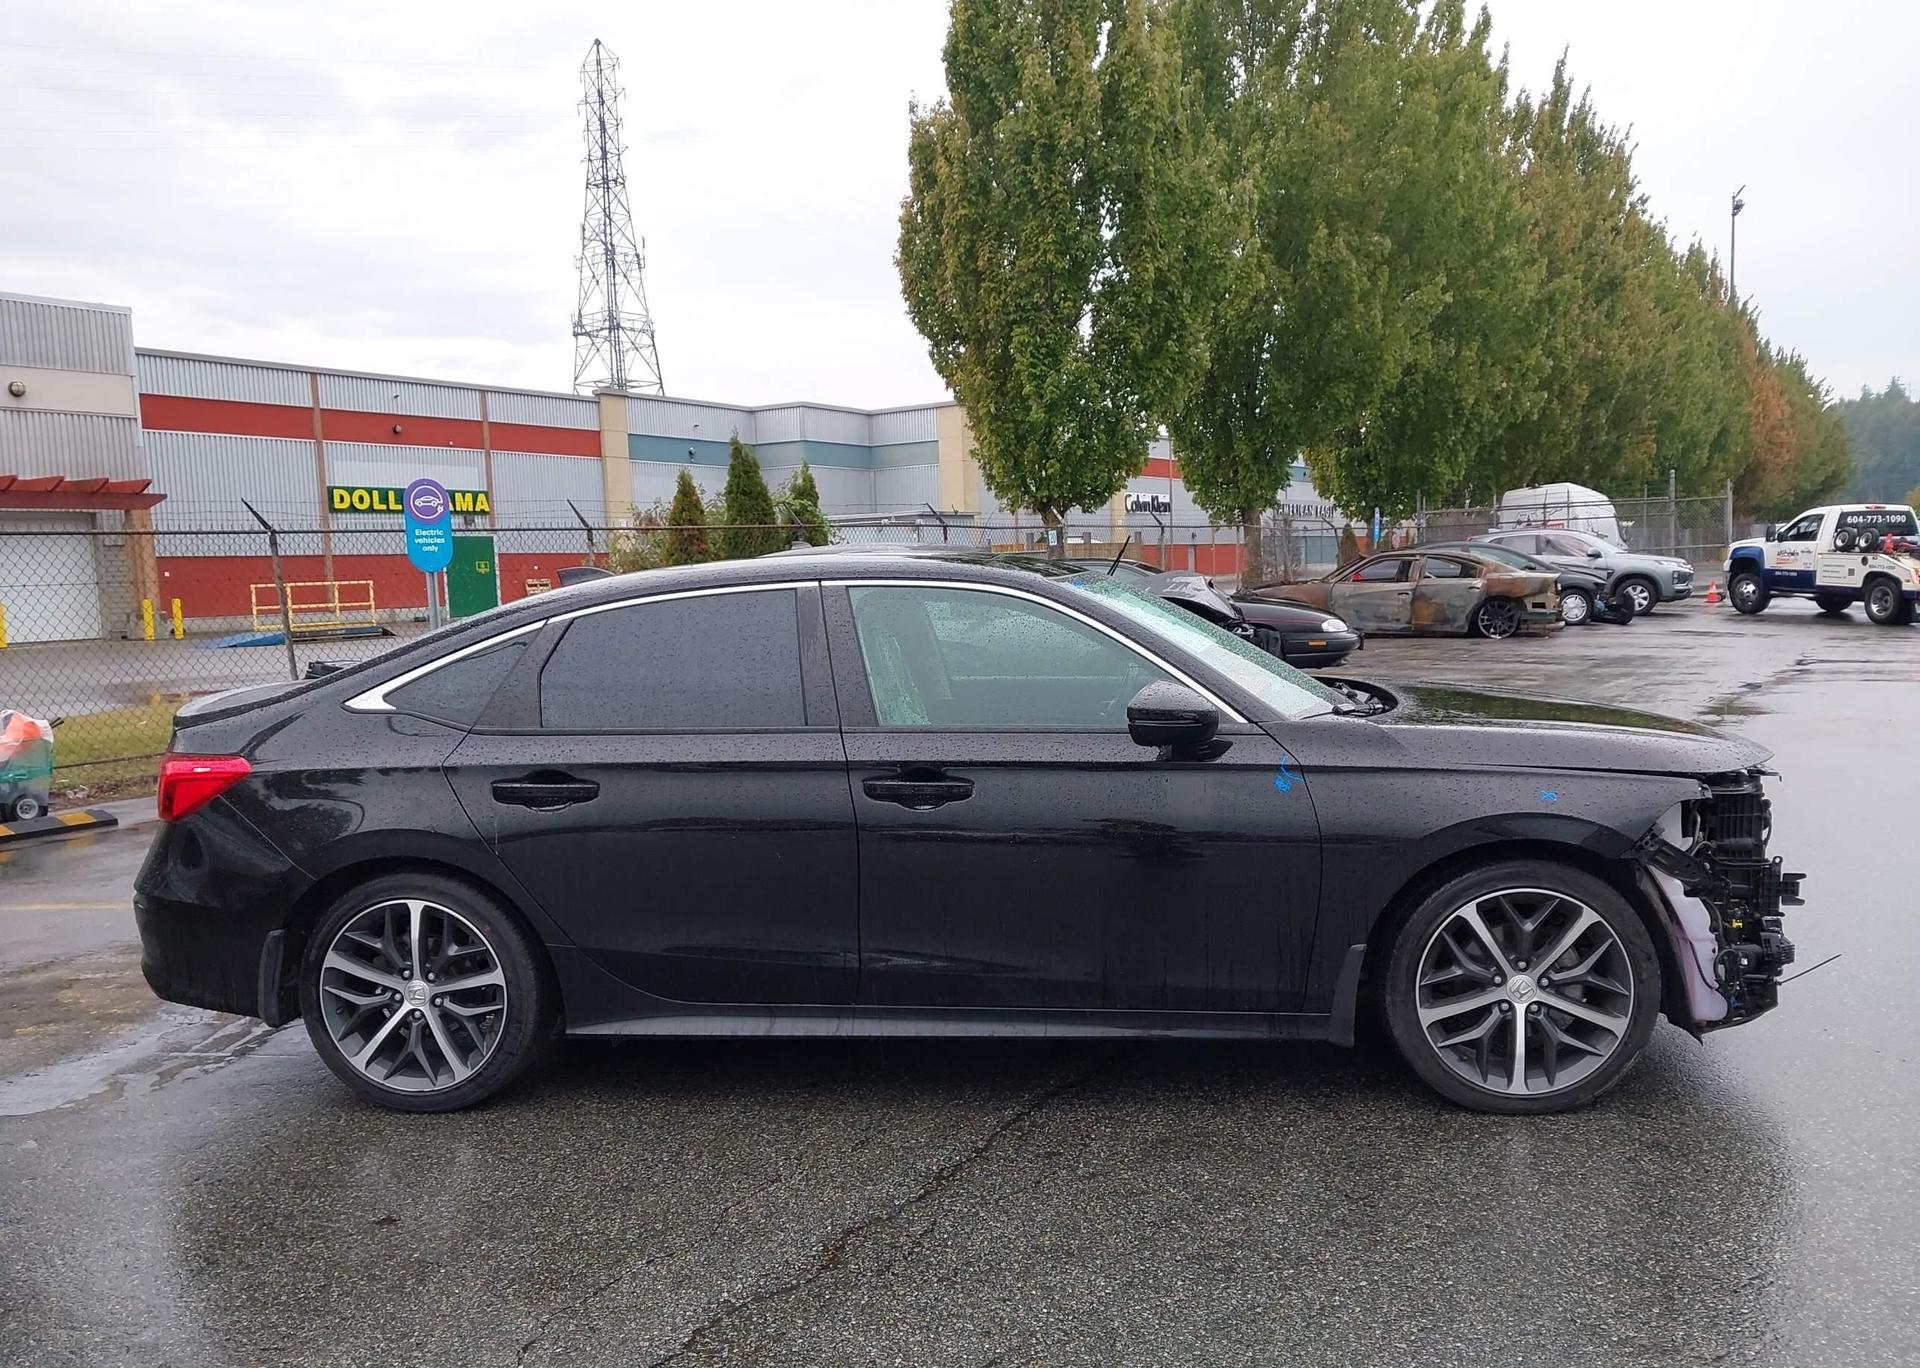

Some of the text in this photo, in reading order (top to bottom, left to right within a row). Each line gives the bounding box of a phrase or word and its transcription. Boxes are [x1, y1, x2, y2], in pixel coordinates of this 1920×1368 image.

[333, 488, 490, 512] DOLLMA
[1125, 493, 1171, 513] Calvin Klein
[1847, 514, 1907, 524] 604-773-1090
[414, 528, 444, 536] Electric
[414, 536, 446, 544] vehicles
[422, 544, 439, 553] only
